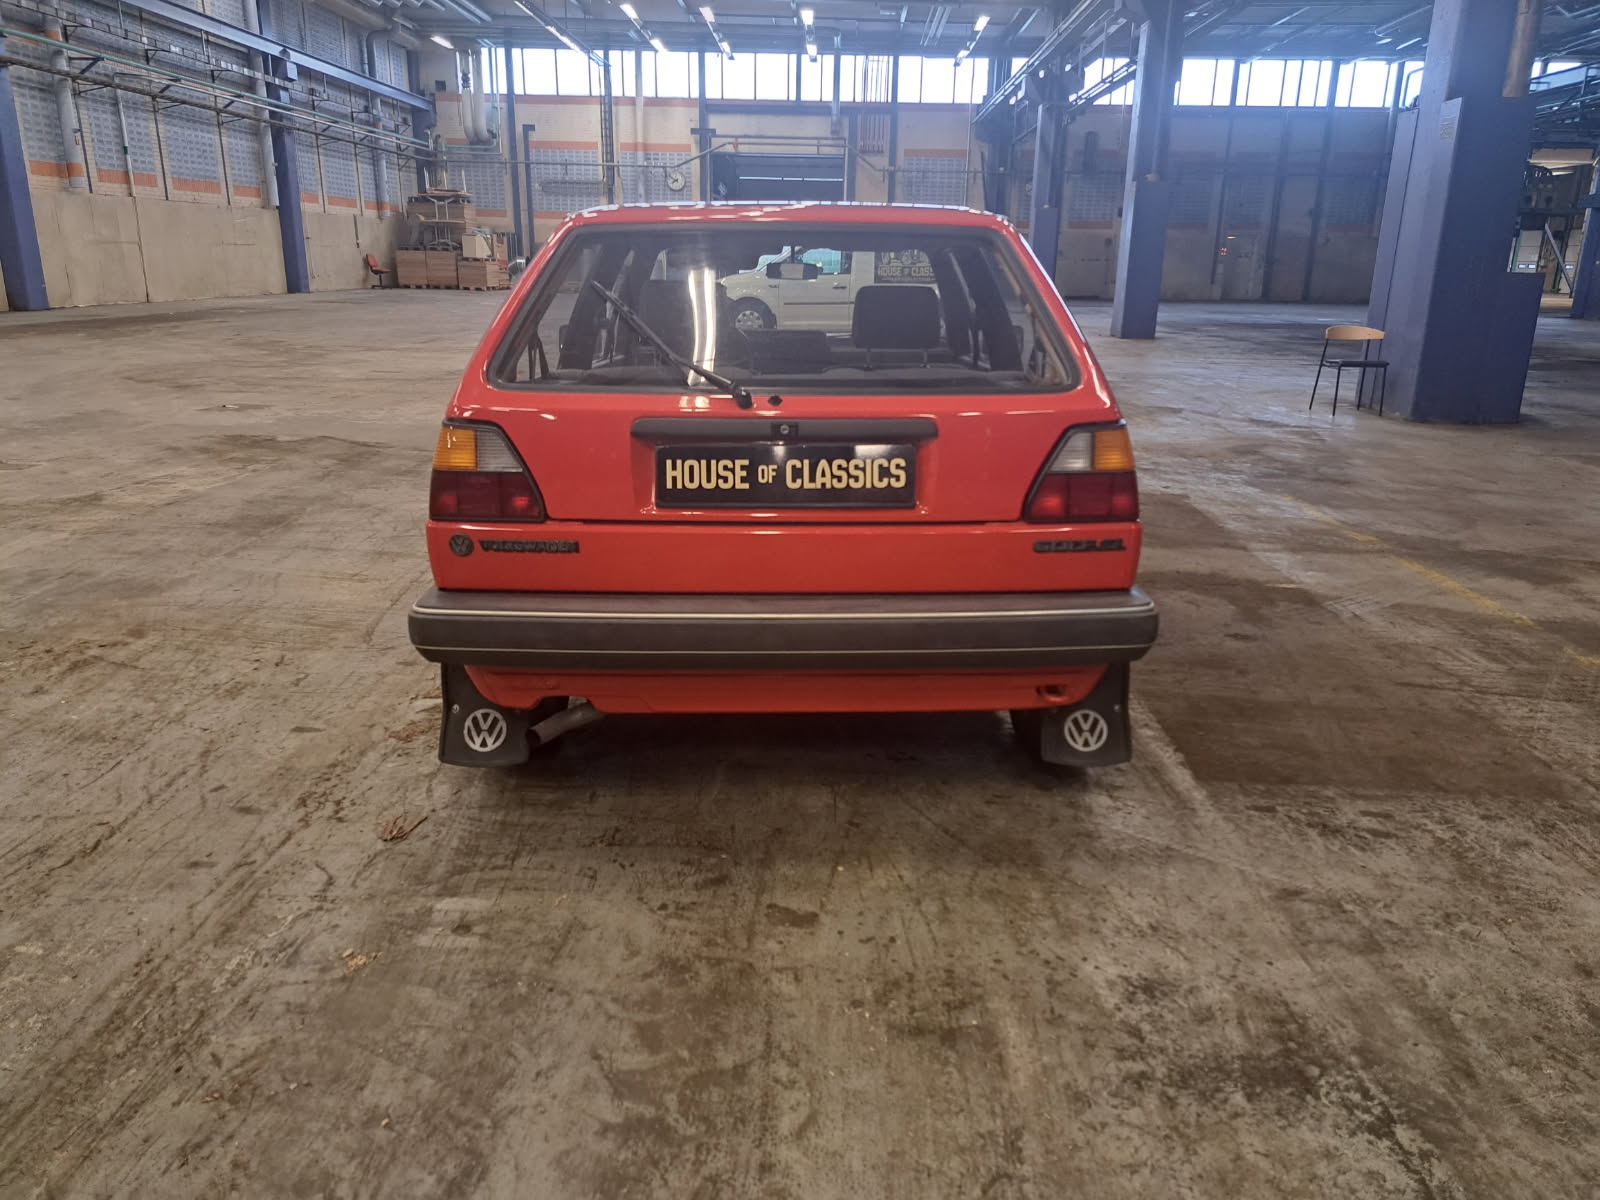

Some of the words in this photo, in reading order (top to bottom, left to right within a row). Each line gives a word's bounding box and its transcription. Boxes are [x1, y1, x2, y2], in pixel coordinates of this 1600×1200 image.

[878, 266, 902, 276] HOUSE
[665, 459, 750, 489] HOUSE
[757, 464, 778, 484] OF
[785, 458, 907, 489] CLASSICS
[463, 708, 508, 753] VW
[1064, 709, 1109, 753] VW
